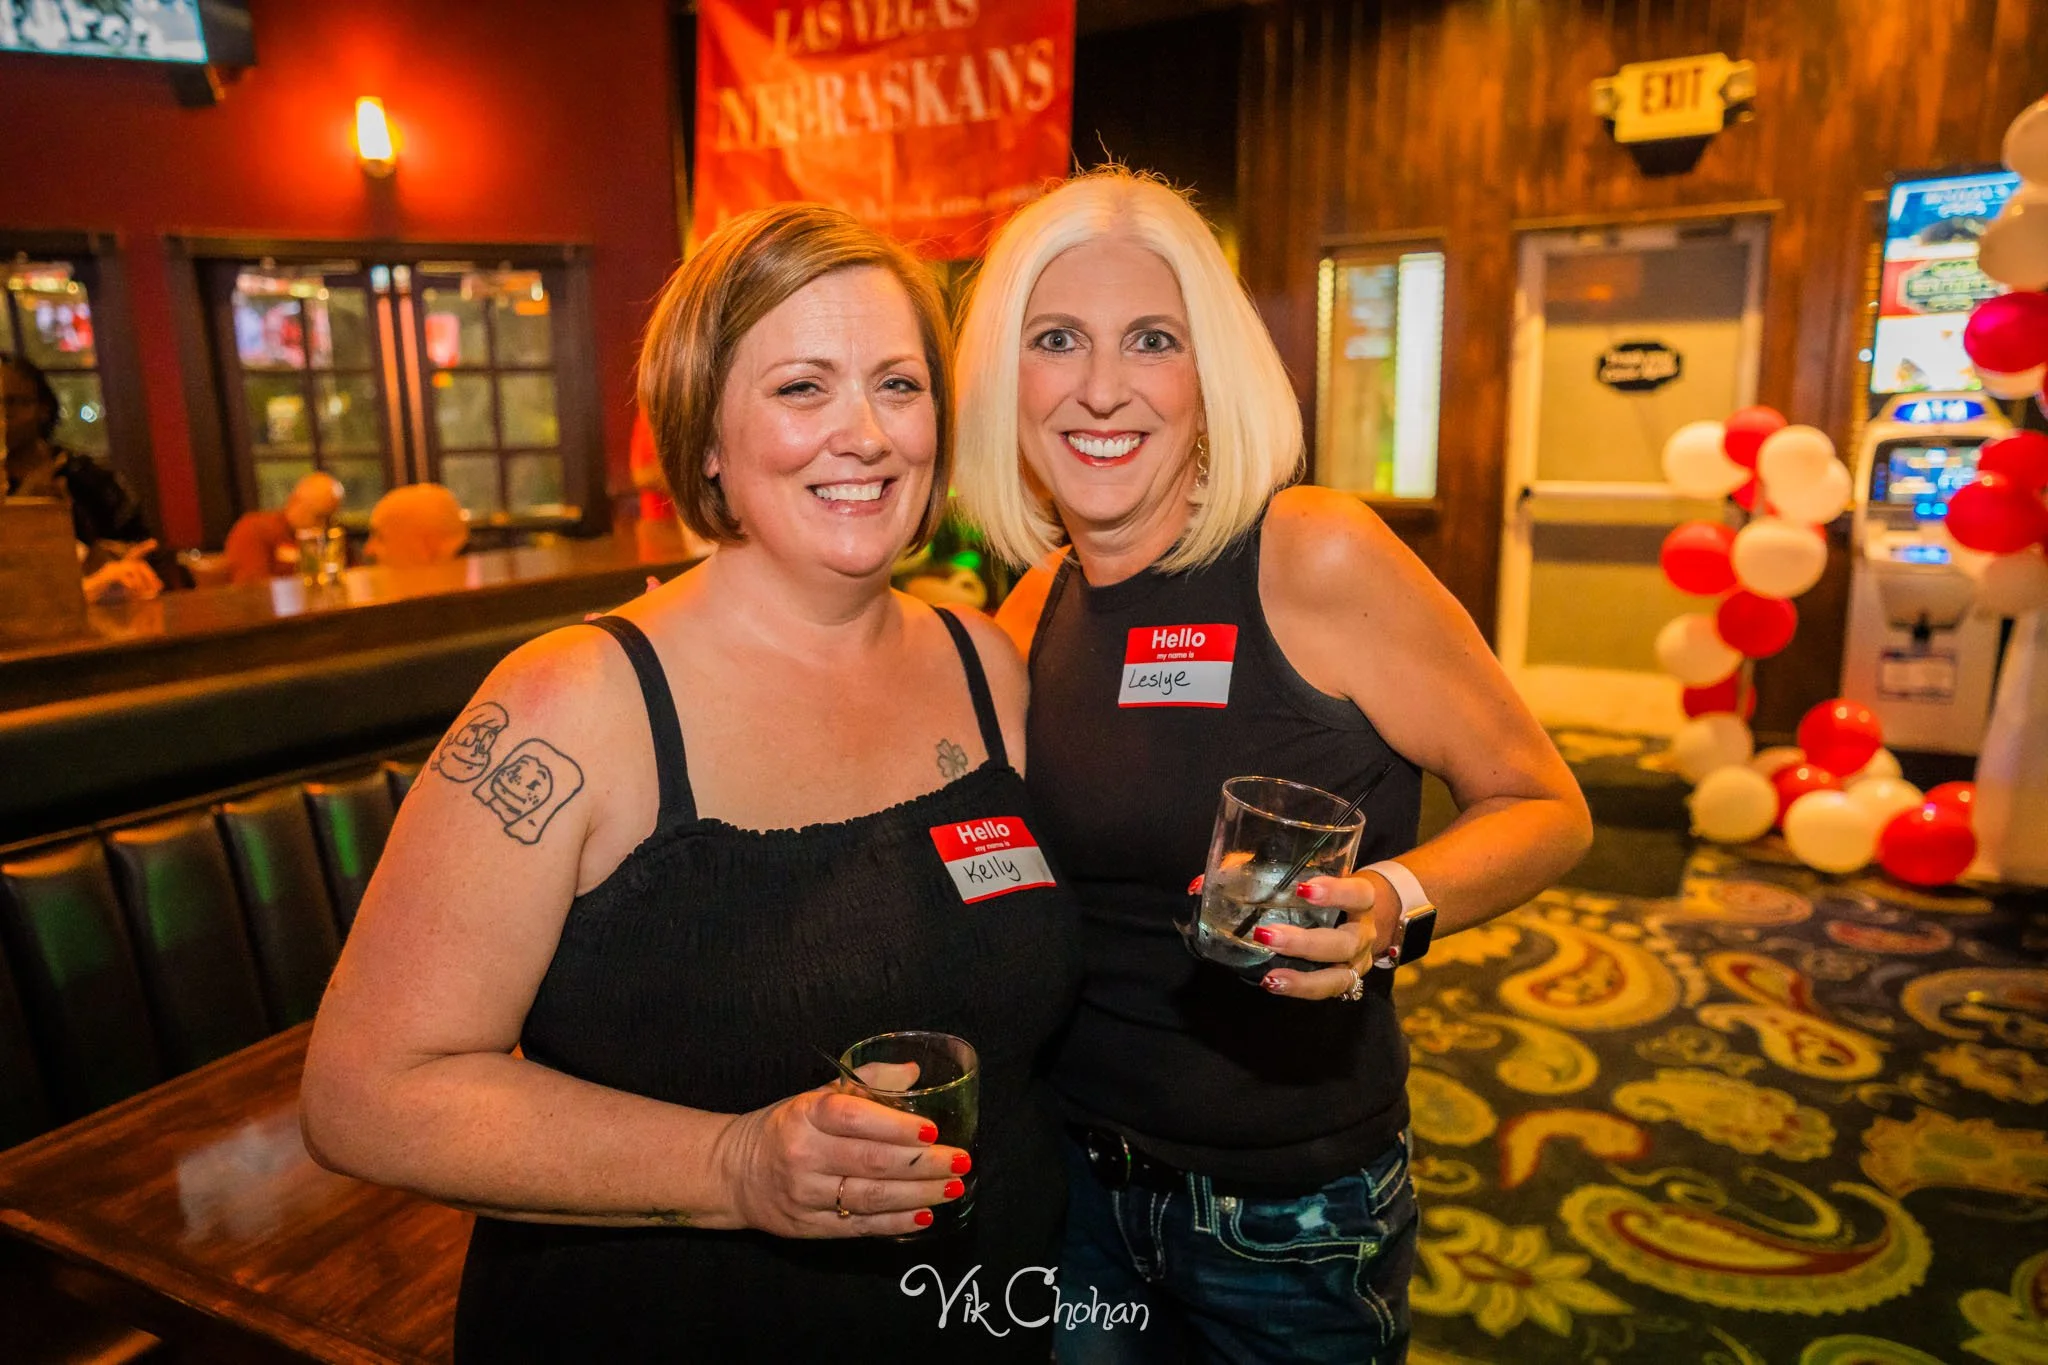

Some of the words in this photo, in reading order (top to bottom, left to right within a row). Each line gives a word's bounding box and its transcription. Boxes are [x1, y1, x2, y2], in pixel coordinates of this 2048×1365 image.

[717, 38, 1056, 151] NEBRASKANS
[1642, 67, 1703, 115] EXIT
[1151, 627, 1206, 649] Hello
[1156, 652, 1167, 660] my
[1188, 651, 1194, 659] is
[1128, 668, 1190, 696] Leslye
[956, 820, 1010, 844] Hello
[975, 845, 986, 853] my
[987, 841, 1004, 850] name
[963, 856, 1021, 883] Kelly
